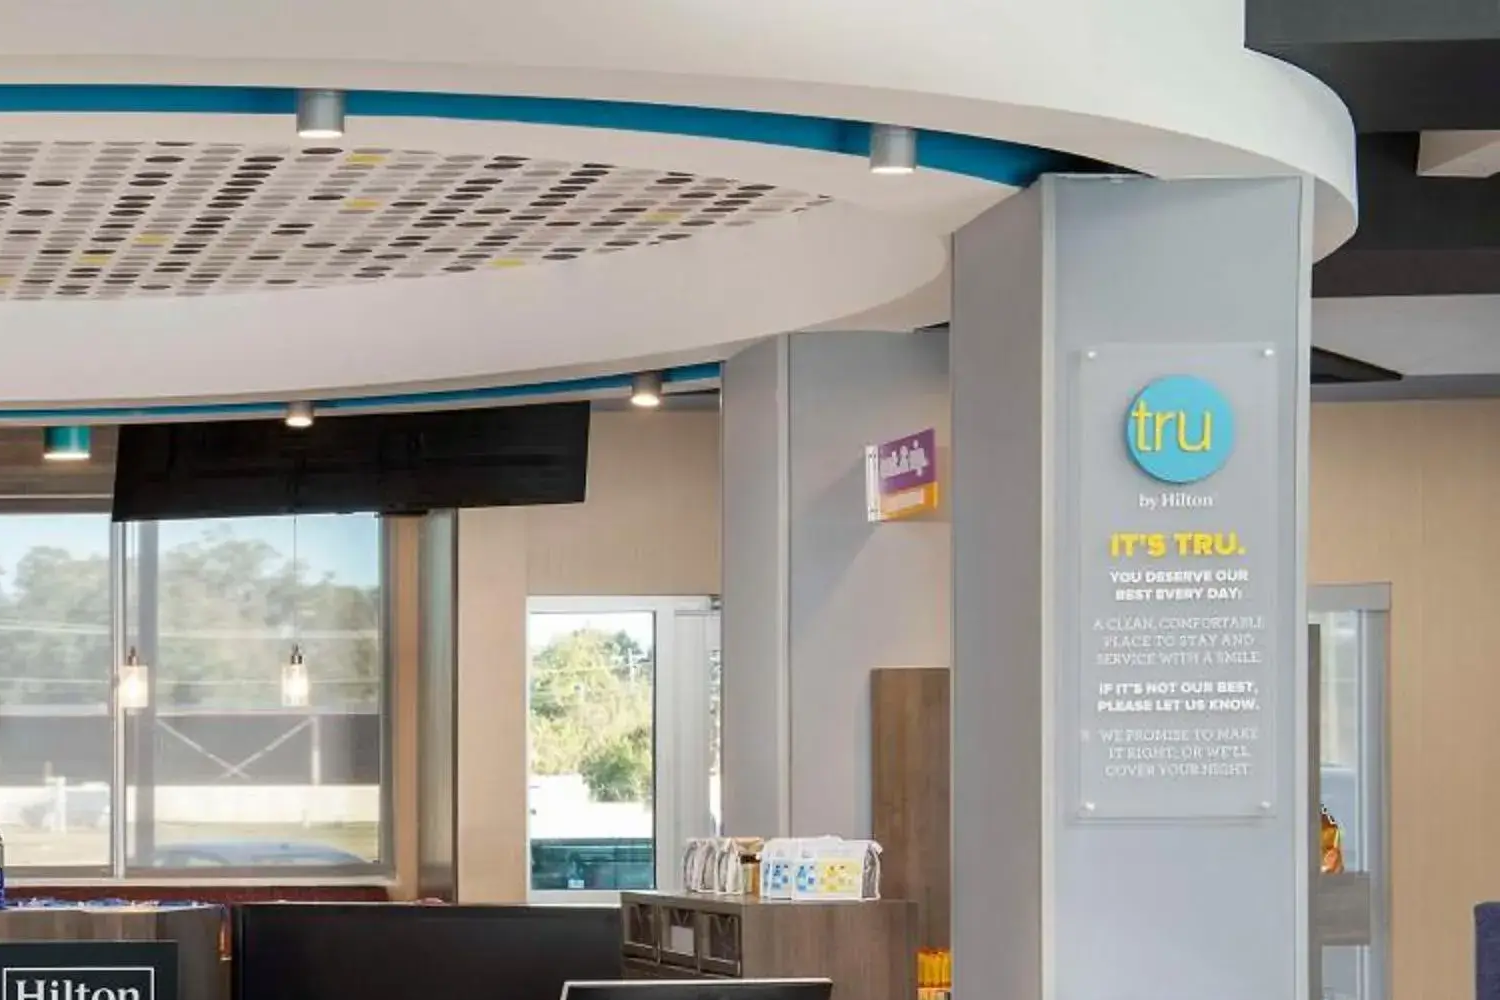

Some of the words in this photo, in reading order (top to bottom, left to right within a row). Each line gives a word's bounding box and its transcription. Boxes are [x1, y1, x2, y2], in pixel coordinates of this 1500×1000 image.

[1132, 399, 1212, 452] tru
[1139, 493, 1156, 510] by
[1161, 492, 1214, 507] Hilton
[1111, 531, 1167, 557] IT'S
[1174, 530, 1247, 556] TRU.
[1109, 570, 1141, 584] YOU
[1145, 570, 1212, 583] DESERVE
[1215, 569, 1248, 582] OUR
[1115, 588, 1152, 601] BEST
[1155, 588, 1203, 601] EVERY
[1093, 618, 1104, 631] A
[1104, 634, 1152, 648] PLACE
[1156, 634, 1176, 648] TO
[1179, 633, 1218, 647] STAY
[1221, 632, 1255, 646] AND
[1099, 652, 1156, 666] SERVICE
[1159, 652, 1199, 665] WITH
[1099, 681, 1114, 695] IF
[1116, 681, 1144, 695] IT'S
[1146, 681, 1178, 694] NOT
[1180, 680, 1213, 693] OUR
[1216, 680, 1259, 695] BEST,
[1097, 699, 1153, 712] PLEASE
[1155, 699, 1181, 711] LET
[1185, 699, 1206, 711] US
[1208, 698, 1261, 711] KNOW.
[1100, 728, 1124, 742] WE
[1126, 728, 1190, 742] PROMISE
[1195, 728, 1215, 742] TO
[1217, 727, 1258, 740] MAKE
[1108, 746, 1123, 760] IT
[1181, 746, 1204, 759] OR
[1104, 764, 1155, 778] COVER
